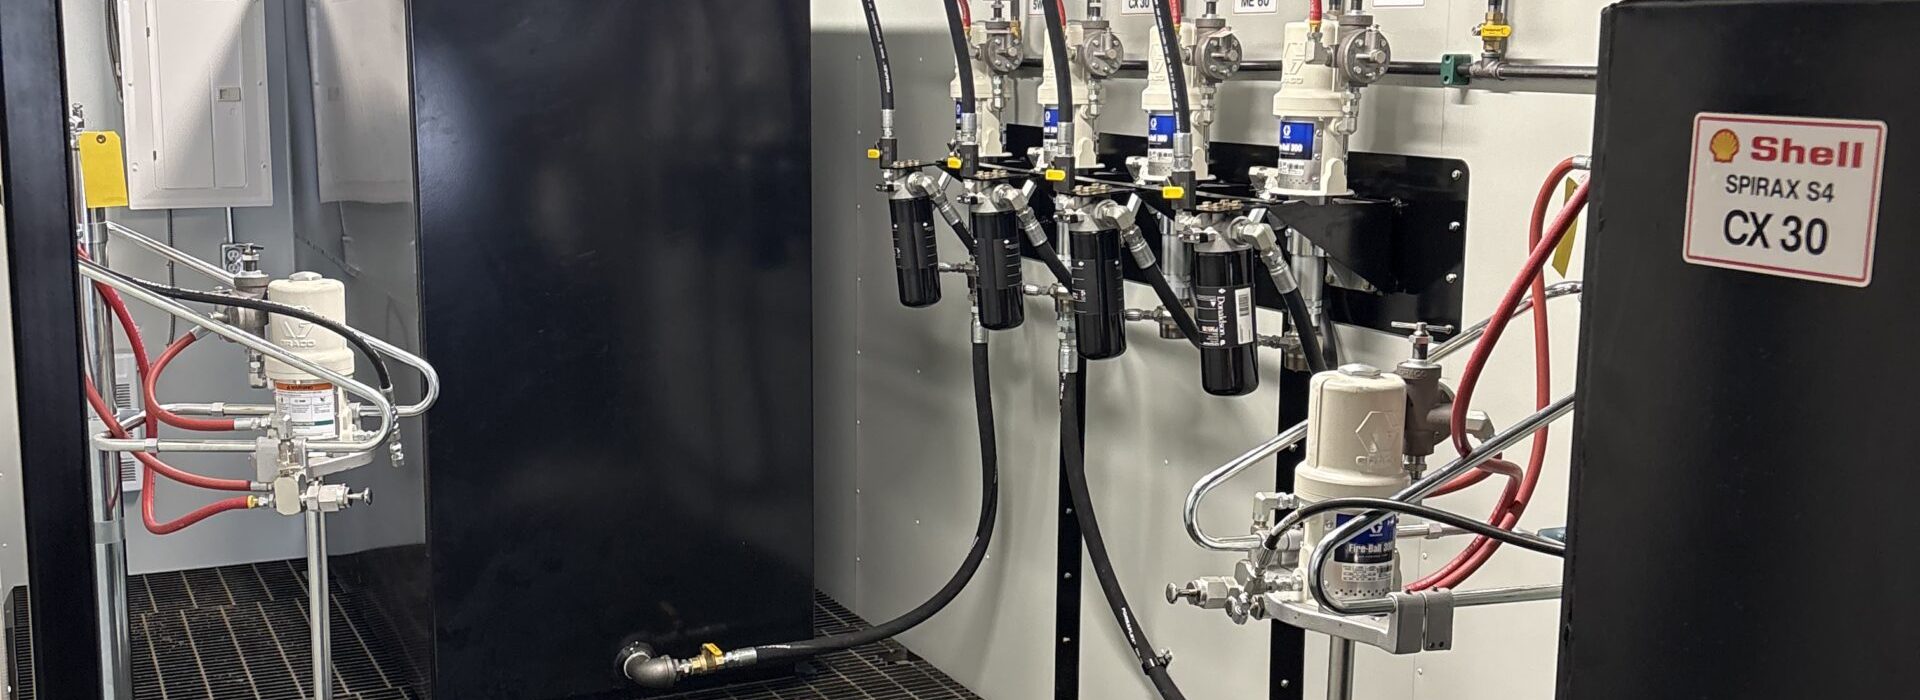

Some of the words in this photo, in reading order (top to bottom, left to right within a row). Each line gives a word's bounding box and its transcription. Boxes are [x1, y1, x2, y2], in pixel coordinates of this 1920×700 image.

[1751, 135, 1864, 168] Shell
[1725, 174, 1801, 200] SPIRAX
[1806, 181, 1835, 203] S4
[1723, 209, 1774, 249] CX
[1780, 215, 1829, 256] 30
